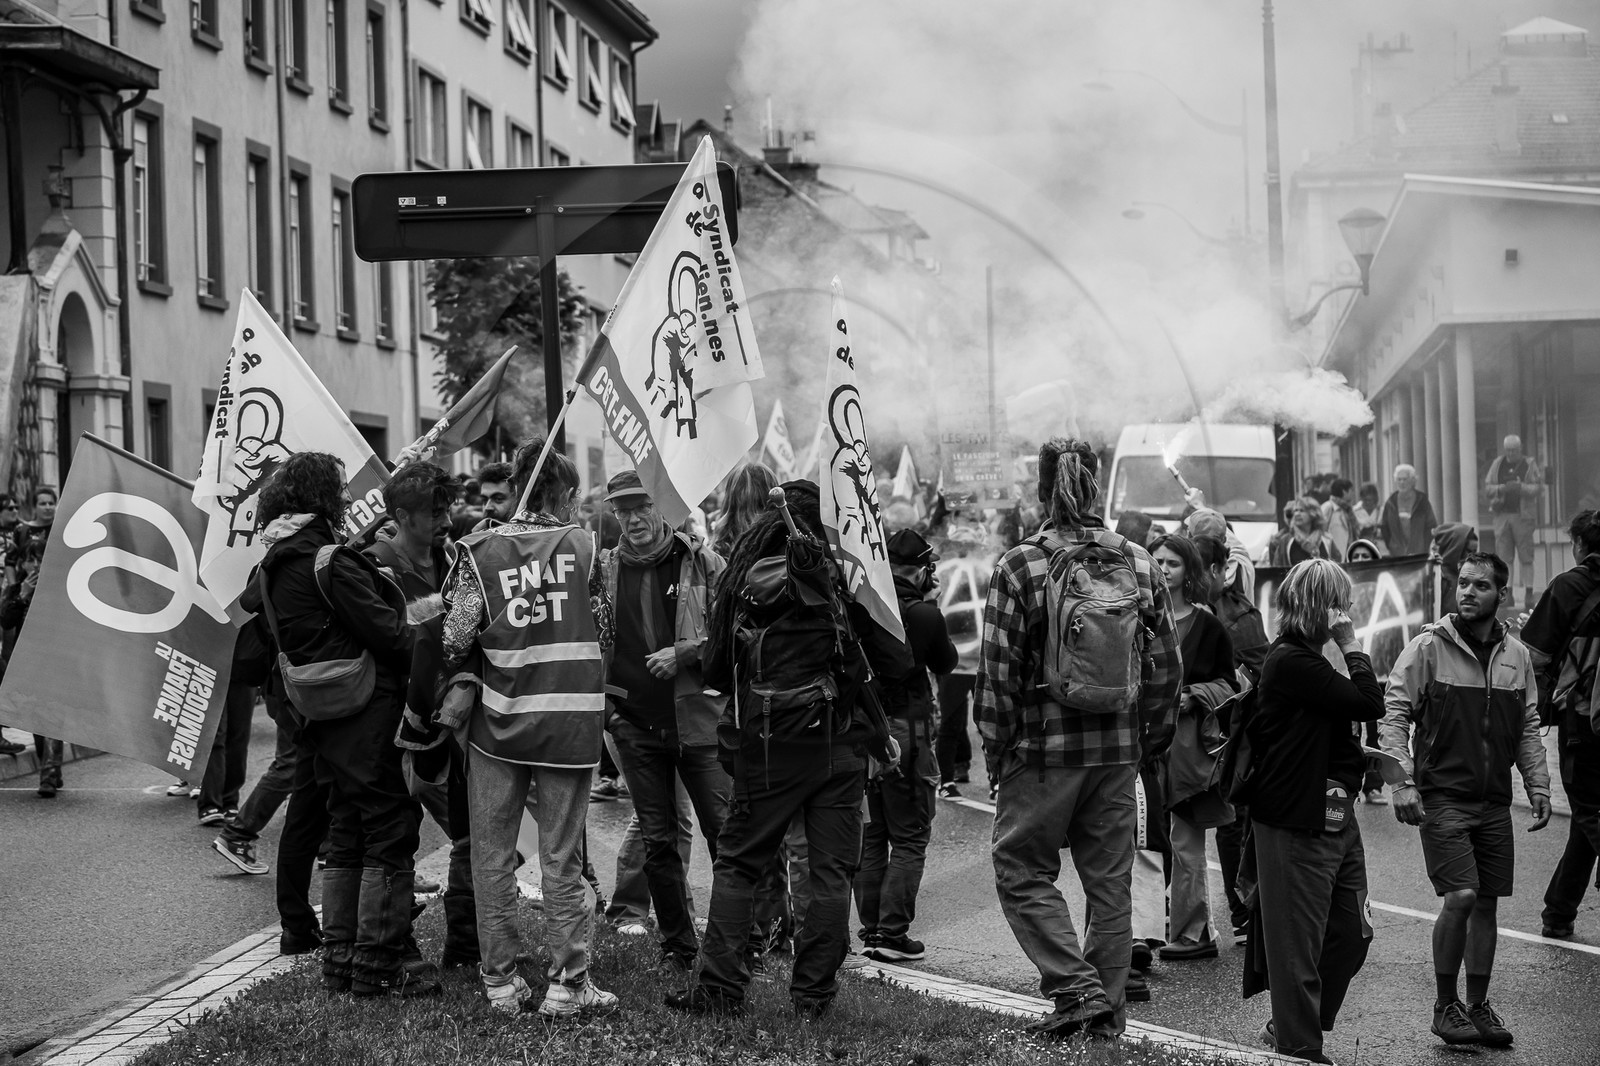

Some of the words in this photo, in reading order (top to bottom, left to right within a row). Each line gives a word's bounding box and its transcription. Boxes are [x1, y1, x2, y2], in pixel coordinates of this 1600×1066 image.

[702, 203, 739, 314] Syndicat
[589, 365, 653, 466] CGT-FNAF
[498, 553, 576, 600] FNAF
[506, 591, 569, 628] CGT
